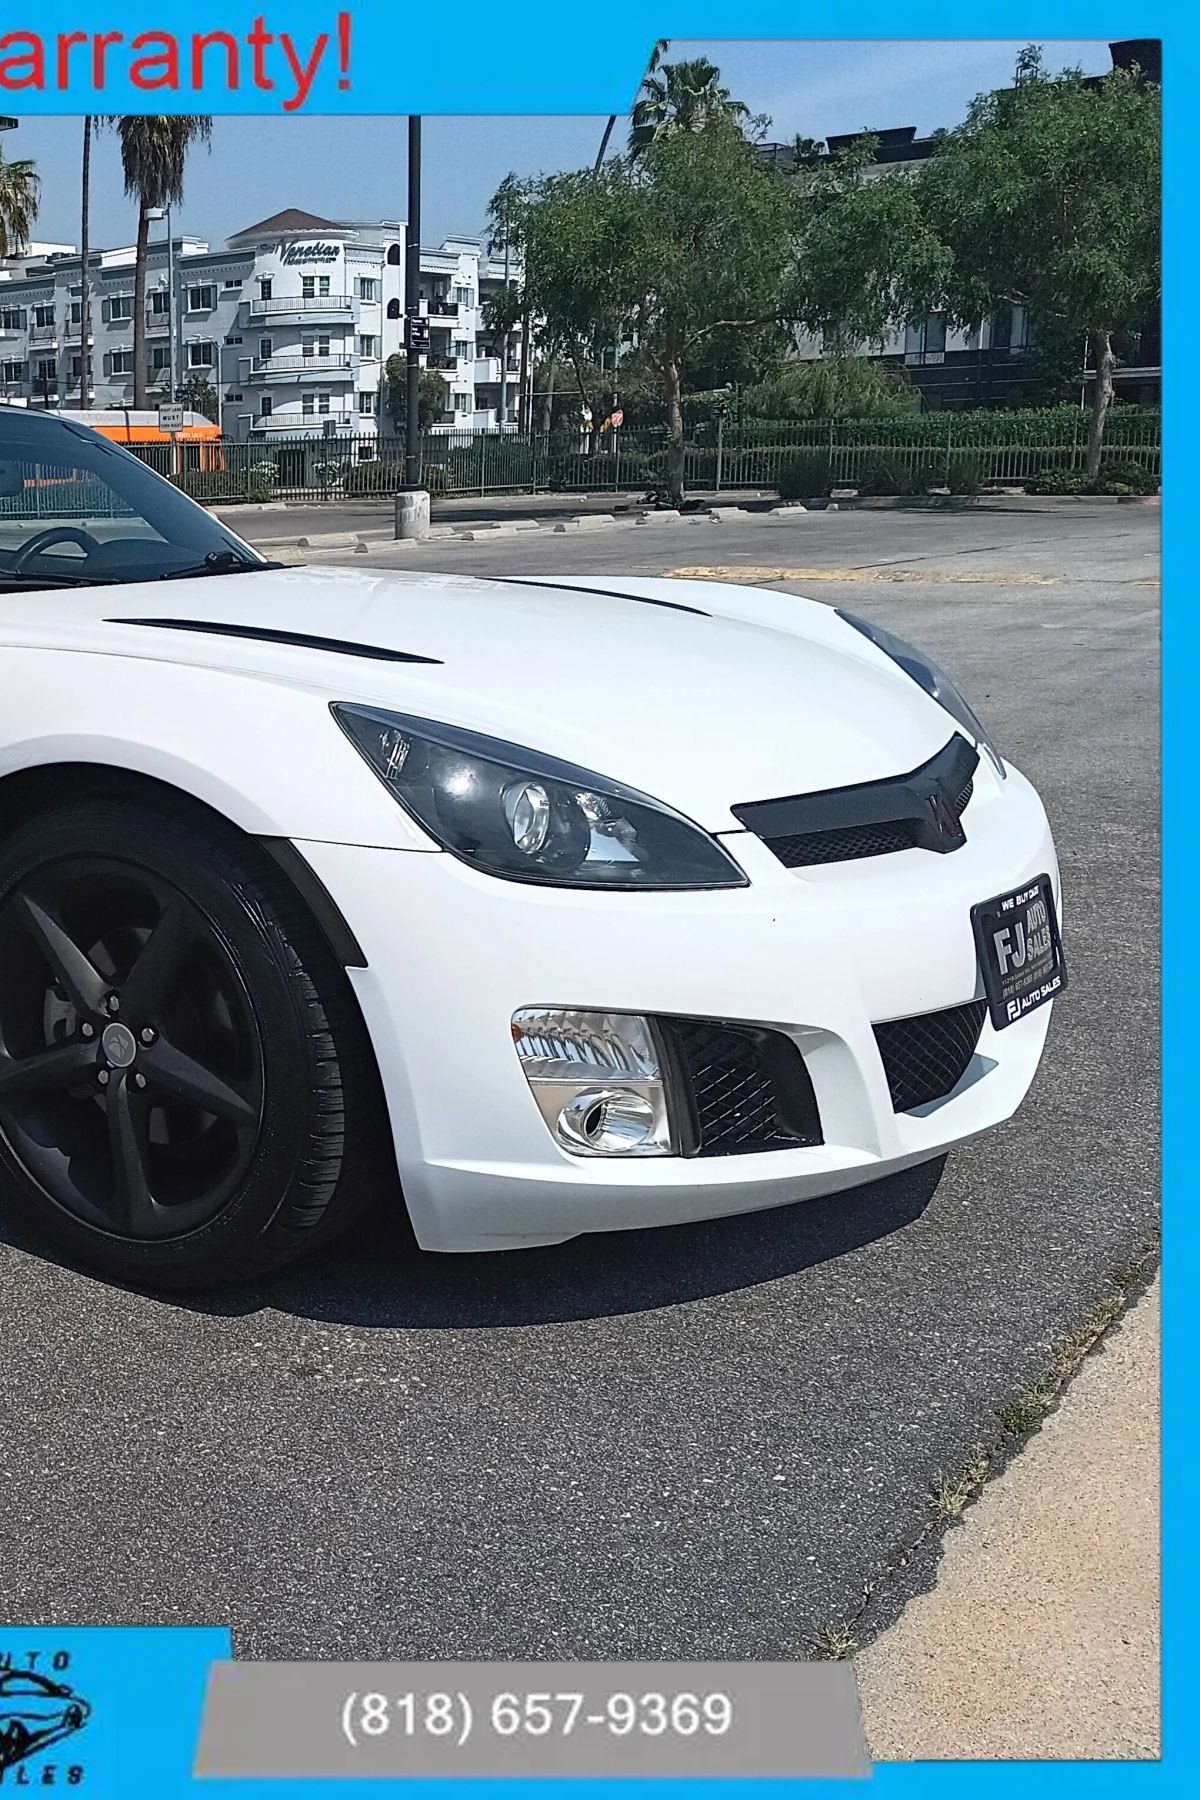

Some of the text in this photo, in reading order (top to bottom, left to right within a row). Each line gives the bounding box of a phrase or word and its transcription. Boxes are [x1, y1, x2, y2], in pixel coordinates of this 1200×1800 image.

[275, 239, 340, 263] Venetian
[1001, 898, 1015, 911] WE
[1016, 893, 1029, 906] BUY
[1026, 900, 1046, 934] AUTO
[993, 921, 1026, 976] FJ
[1026, 924, 1051, 961] SALES
[1006, 975, 1061, 1021] FJ AUTO SALES
